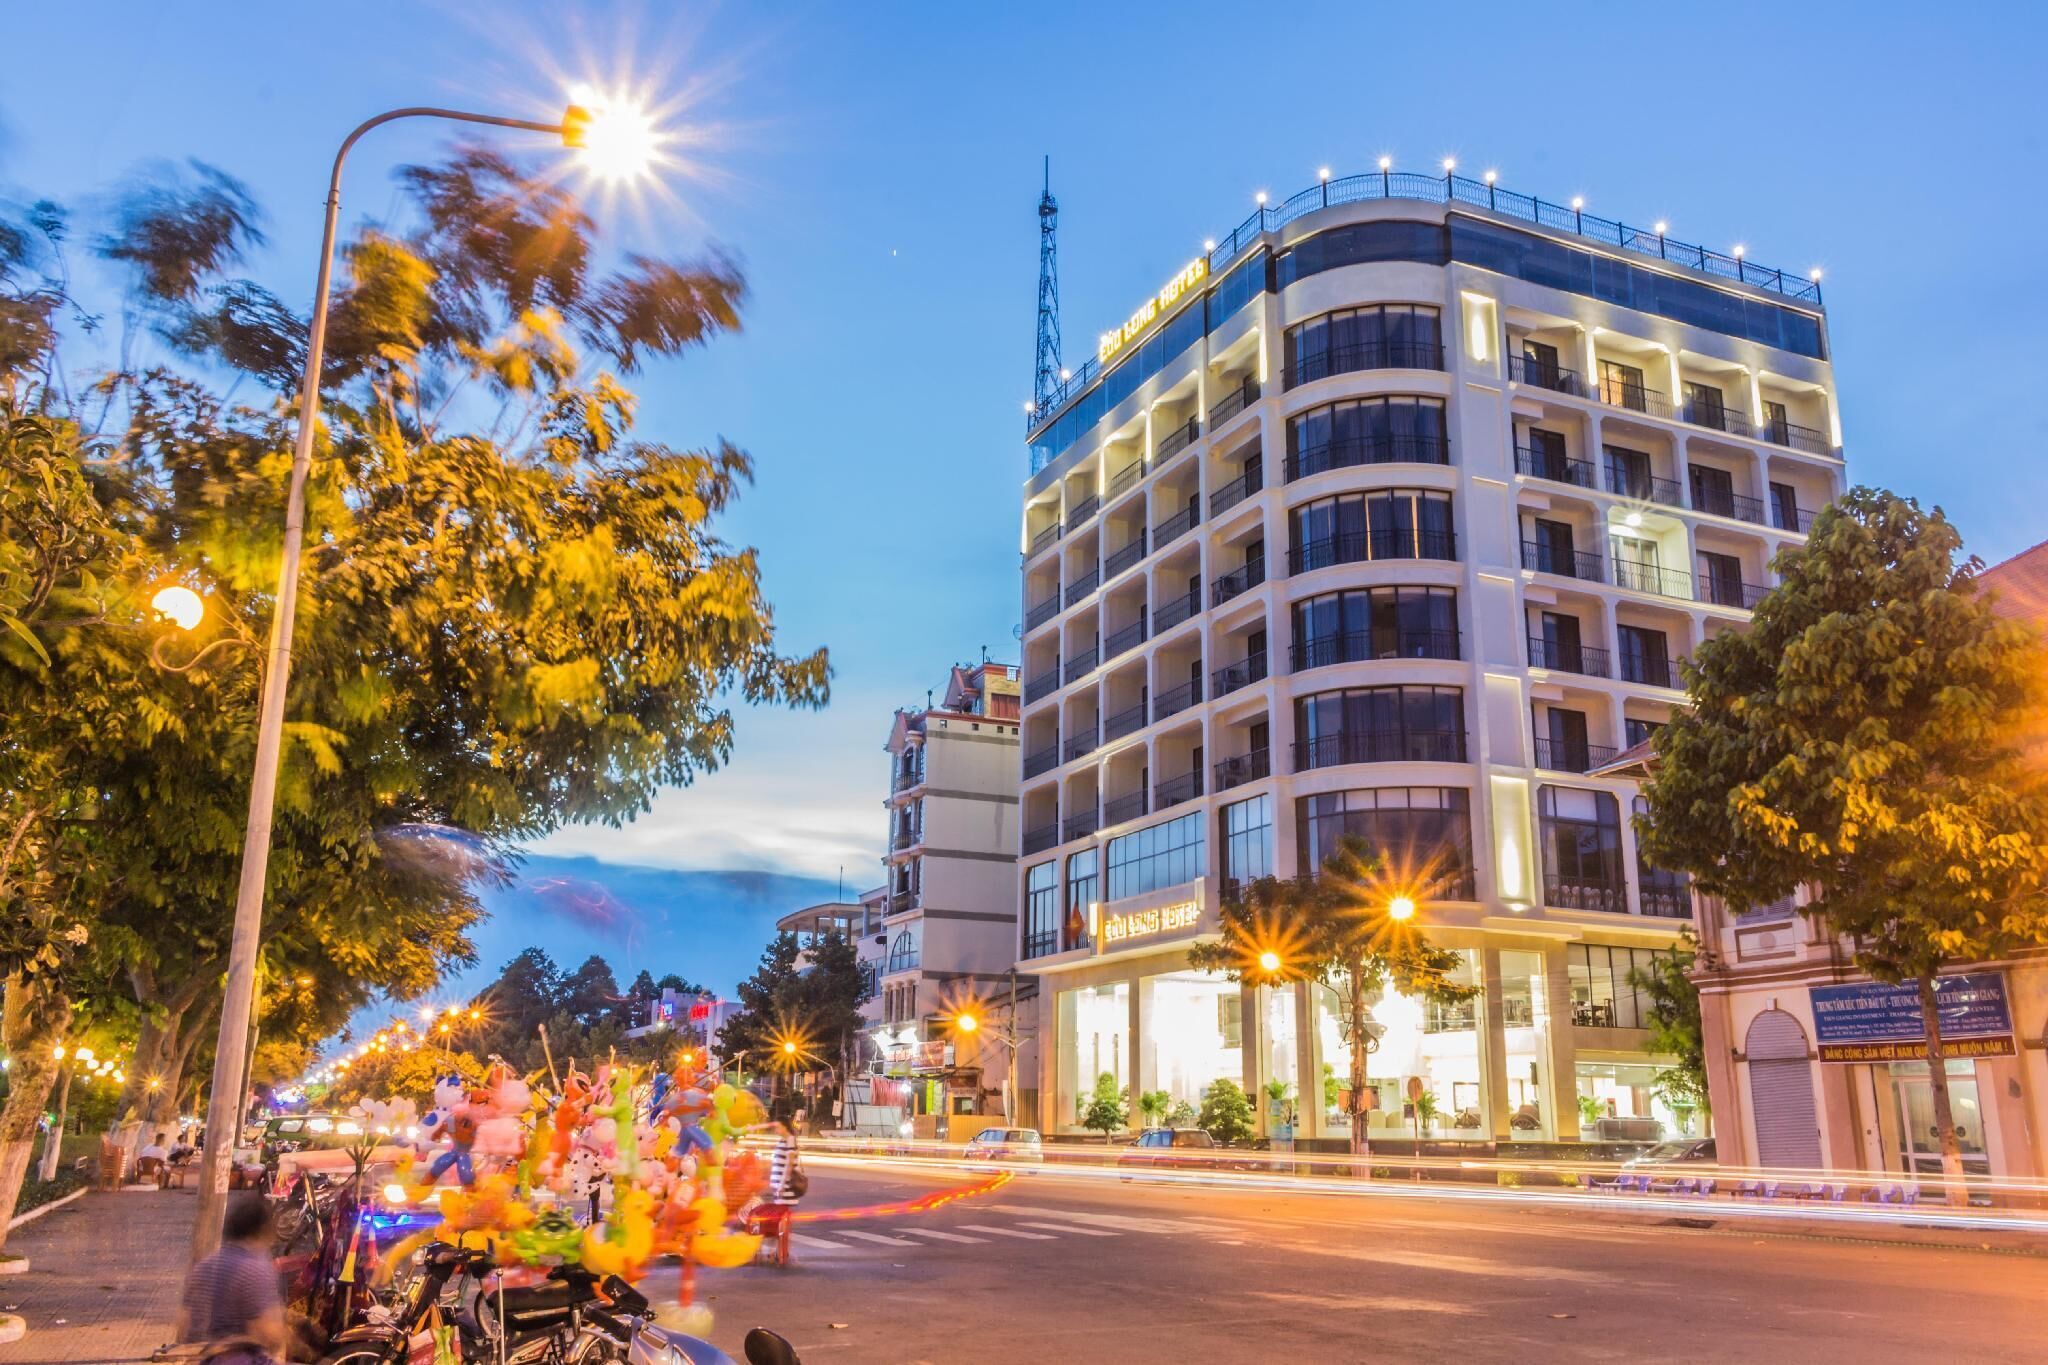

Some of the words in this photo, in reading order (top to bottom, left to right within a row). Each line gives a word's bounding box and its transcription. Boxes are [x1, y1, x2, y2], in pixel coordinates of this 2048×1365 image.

[1124, 298, 1157, 342] LONG
[1160, 257, 1206, 310] HOTEL
[1128, 910, 1159, 936] LONG
[1161, 901, 1199, 930] HOTEL
[1897, 1046, 1912, 1057] NAM
